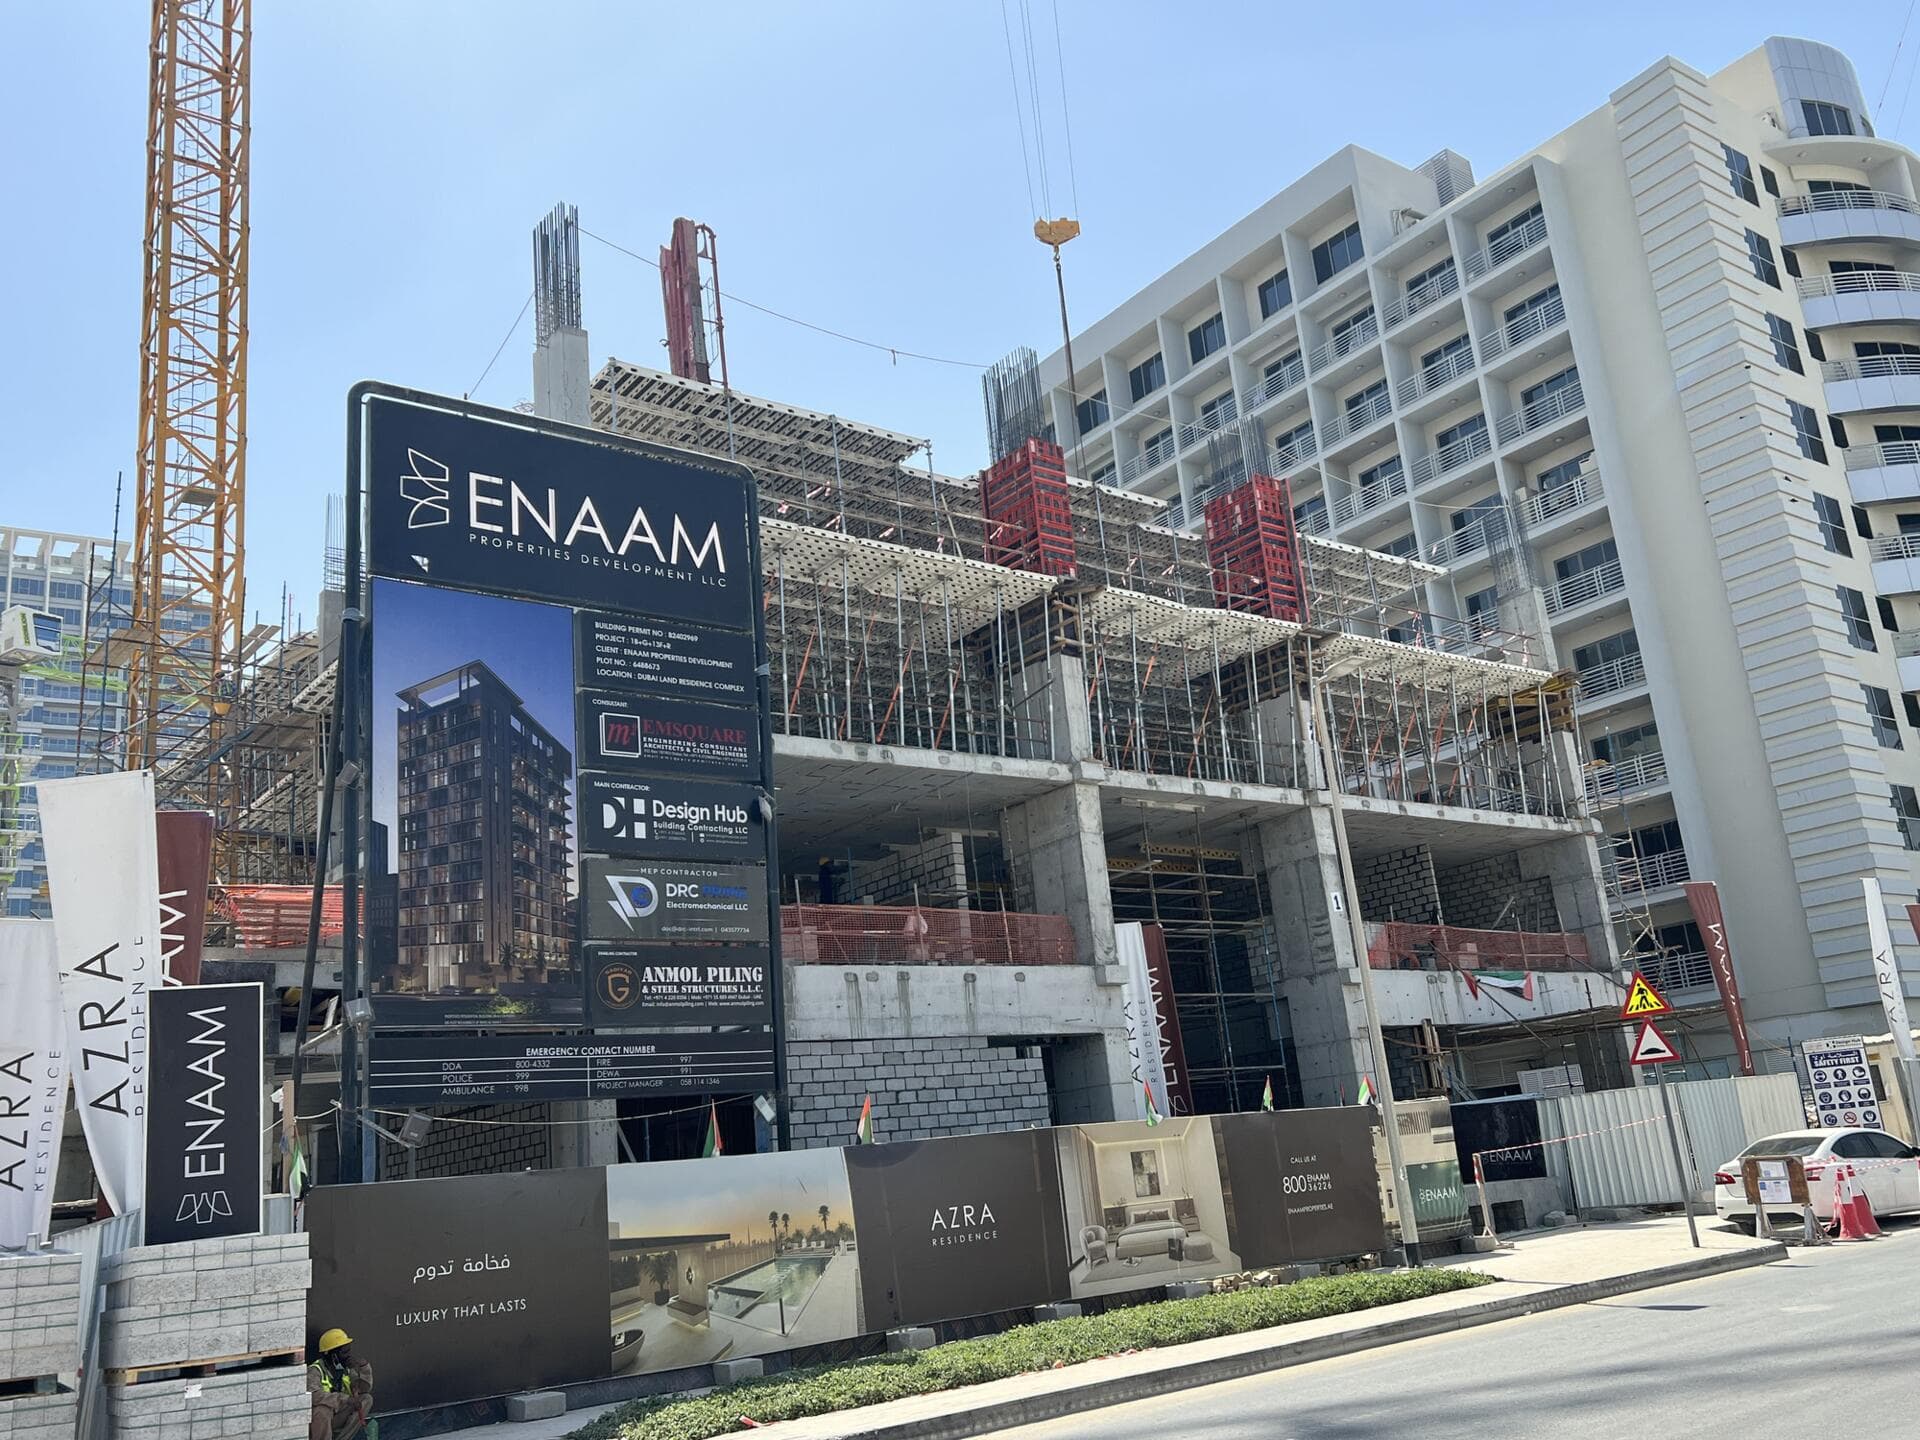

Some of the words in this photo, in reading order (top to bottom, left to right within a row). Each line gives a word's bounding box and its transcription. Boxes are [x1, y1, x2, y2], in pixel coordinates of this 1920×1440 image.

[469, 472, 726, 573] ENAAM
[469, 534, 570, 561] PROPERTIES
[581, 554, 693, 582] DEVELOPMENT
[701, 575, 727, 588] LLC
[595, 622, 627, 632] BUILDING
[628, 625, 651, 635] PERMIT
[652, 629, 663, 637] NO
[595, 633, 626, 643] PROJECT
[595, 645, 619, 654] CLIENT
[624, 649, 650, 658] ENAAM
[651, 652, 687, 663] PROPERTIES
[688, 657, 733, 669] DEVELOPMENT
[596, 657, 614, 665] PLOT
[597, 668, 633, 679] LOCATION
[637, 673, 658, 682] DUBAI
[659, 676, 678, 685] LAND
[679, 678, 713, 689] RESIDENCE
[714, 681, 745, 693] COMPLEX
[642, 719, 747, 744] EMSQUARE
[643, 736, 697, 748] ENGINEERING
[700, 742, 747, 753] CONSULTANT
[643, 743, 684, 753] ARCHITECTS
[712, 750, 748, 759] ENGINEERS
[594, 781, 610, 789] MAIN
[652, 799, 710, 824] Design
[714, 804, 748, 823] Hub
[653, 820, 685, 831] Building
[687, 823, 733, 834] Contracting
[735, 826, 748, 834] LLC
[660, 868, 718, 877] CONTRACTOR
[665, 883, 699, 898] DRC
[666, 901, 734, 910] Electromechanical
[734, 903, 749, 911] LLC
[1330, 894, 1341, 911] 1
[641, 966, 702, 983] ANMOL
[706, 966, 763, 983] PILING
[641, 985, 649, 994] &
[651, 985, 679, 993] STEEL
[681, 985, 738, 994] STRUCTURES
[740, 984, 764, 993] L.L.C.
[74, 942, 129, 1117] AZRA
[1139, 999, 1158, 1083] RESIDENCE
[526, 1047, 579, 1056] EMERGENCY
[581, 1046, 621, 1055] CONTACT
[623, 1045, 656, 1054] NUMBER
[442, 1062, 462, 1071] DDA
[515, 1060, 551, 1069] 800-4332
[596, 1058, 611, 1066] FIRE
[442, 1074, 473, 1083] POLICE
[515, 1072, 530, 1080] 999
[596, 1070, 620, 1078] DEWA
[184, 1005, 226, 1178] ENAAM
[441, 1085, 495, 1096] AMBULANCE
[514, 1084, 529, 1092] 998
[597, 1081, 627, 1090] PROJECT
[628, 1079, 664, 1088] MANAGER
[680, 1078, 692, 1086] 058
[0, 1052, 35, 1191] AZRA
[34, 1051, 61, 1191] RESIDENCE
[1489, 1150, 1533, 1163] ENAAM
[1282, 1174, 1307, 1194] 800
[1306, 1173, 1331, 1183] ENAAM
[1425, 1186, 1457, 1202] ENAAM
[931, 1202, 996, 1231] AZRA
[932, 1230, 998, 1247] RESIDENCE
[412, 1259, 454, 1284] تدوم
[462, 1253, 511, 1273] فخامة
[396, 1308, 449, 1326] LUXURY
[453, 1303, 485, 1318] THAT
[490, 1298, 527, 1314] LASTS
